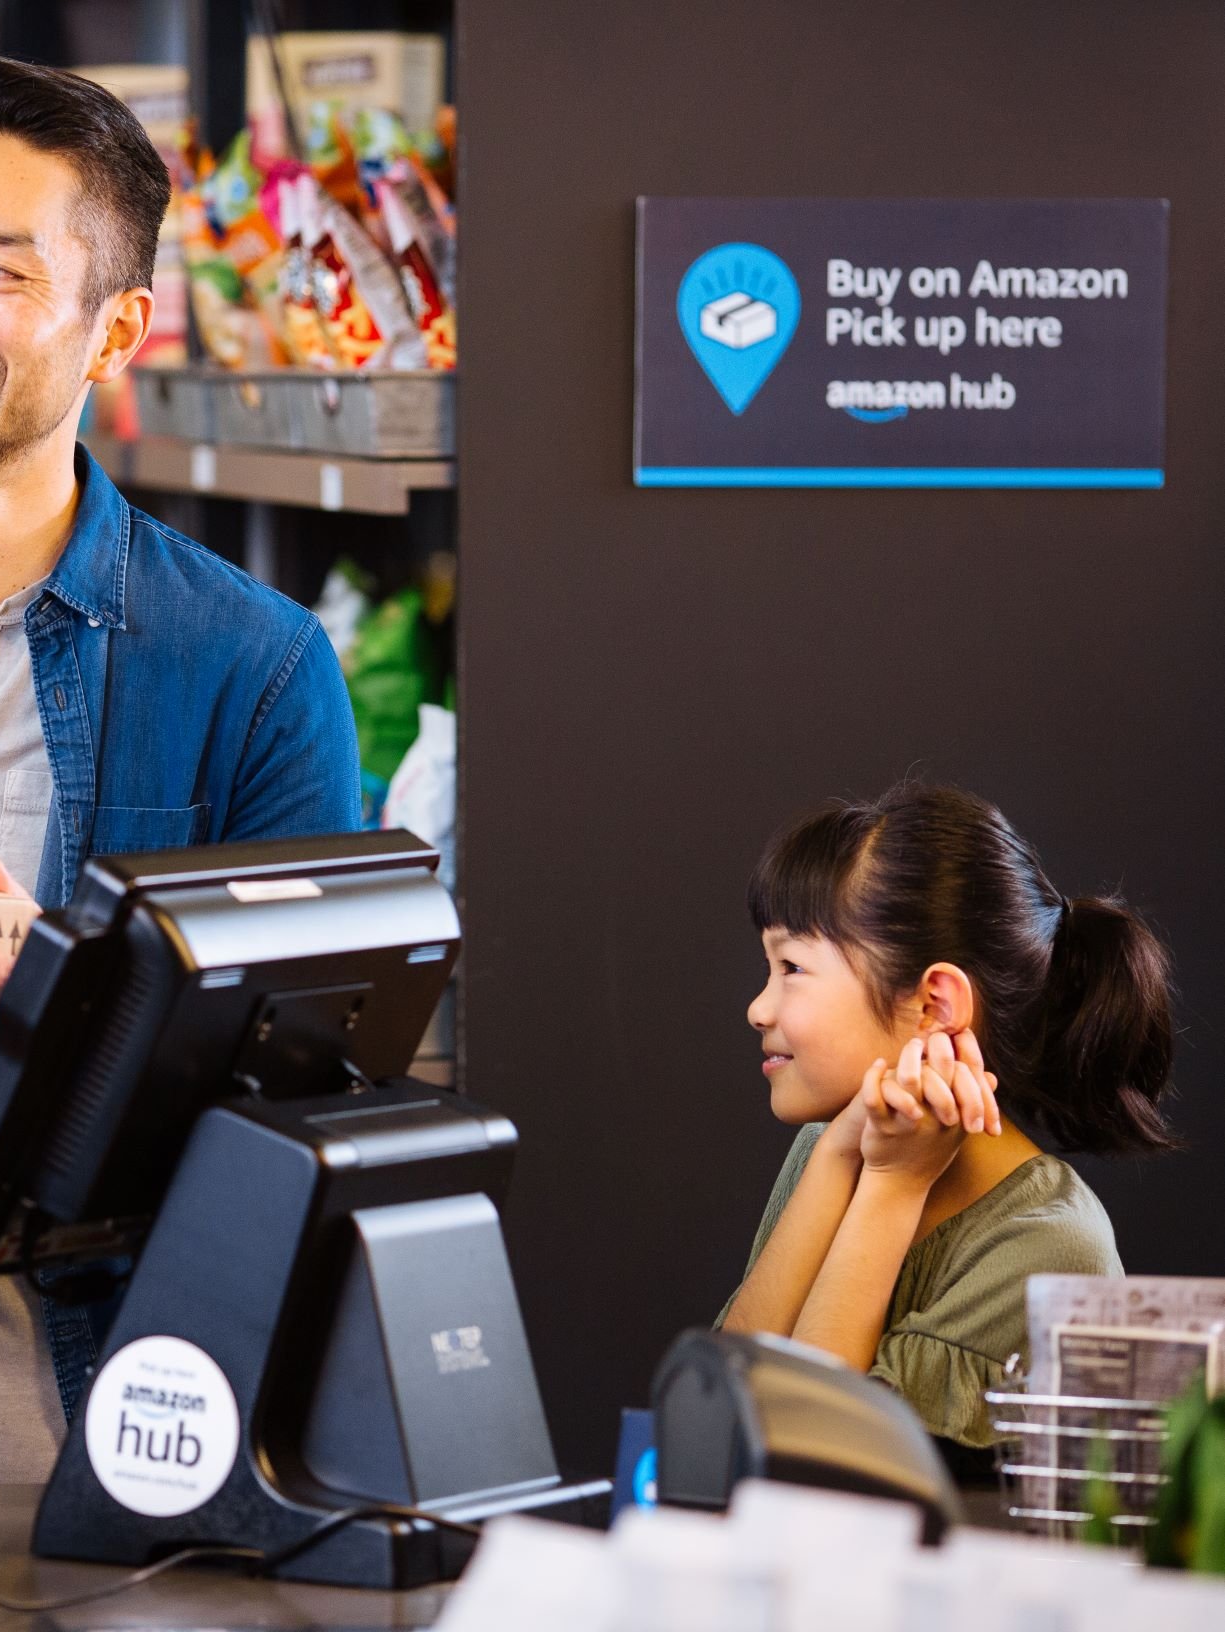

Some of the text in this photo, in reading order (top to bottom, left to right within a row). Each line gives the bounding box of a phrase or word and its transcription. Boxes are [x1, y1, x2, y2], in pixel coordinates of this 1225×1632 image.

[827, 259, 1128, 306] Buy on Amazon
[826, 306, 1063, 355] Pick up here
[826, 372, 1017, 410] amazon hub
[122, 1383, 206, 1413] amazon
[116, 1409, 202, 1468] hub
